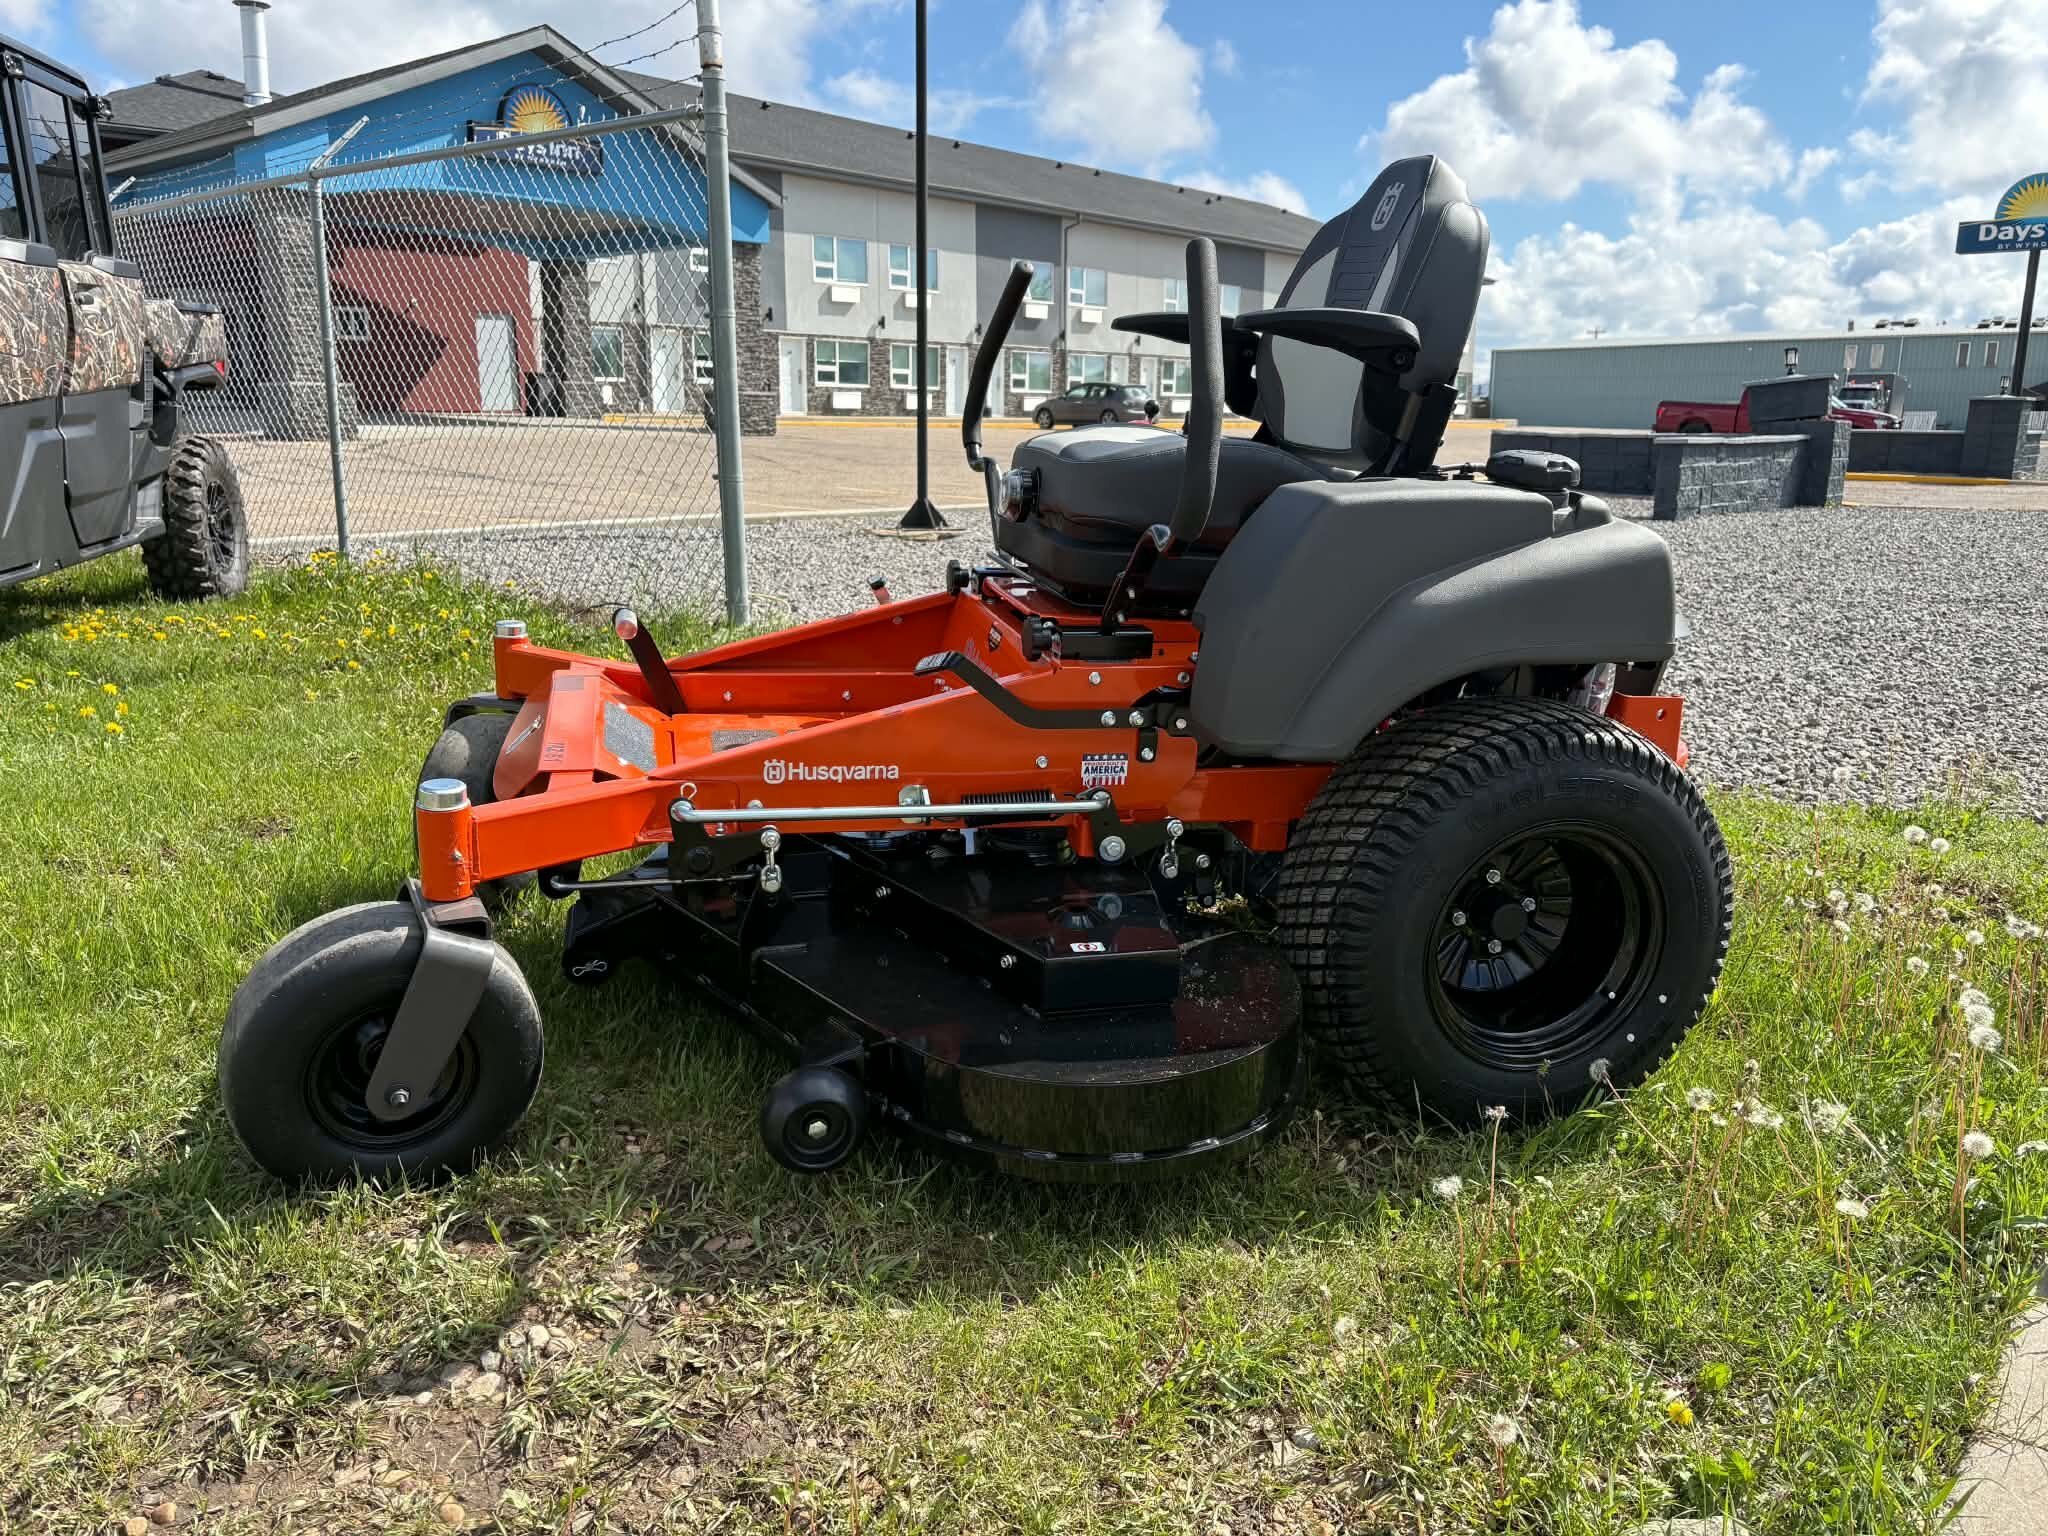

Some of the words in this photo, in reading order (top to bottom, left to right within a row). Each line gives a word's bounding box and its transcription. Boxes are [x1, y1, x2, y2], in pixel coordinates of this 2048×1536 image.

[1978, 224, 2046, 241] Days
[788, 762, 899, 783] Husqvarna
[1084, 766, 1125, 775] AMERICA
